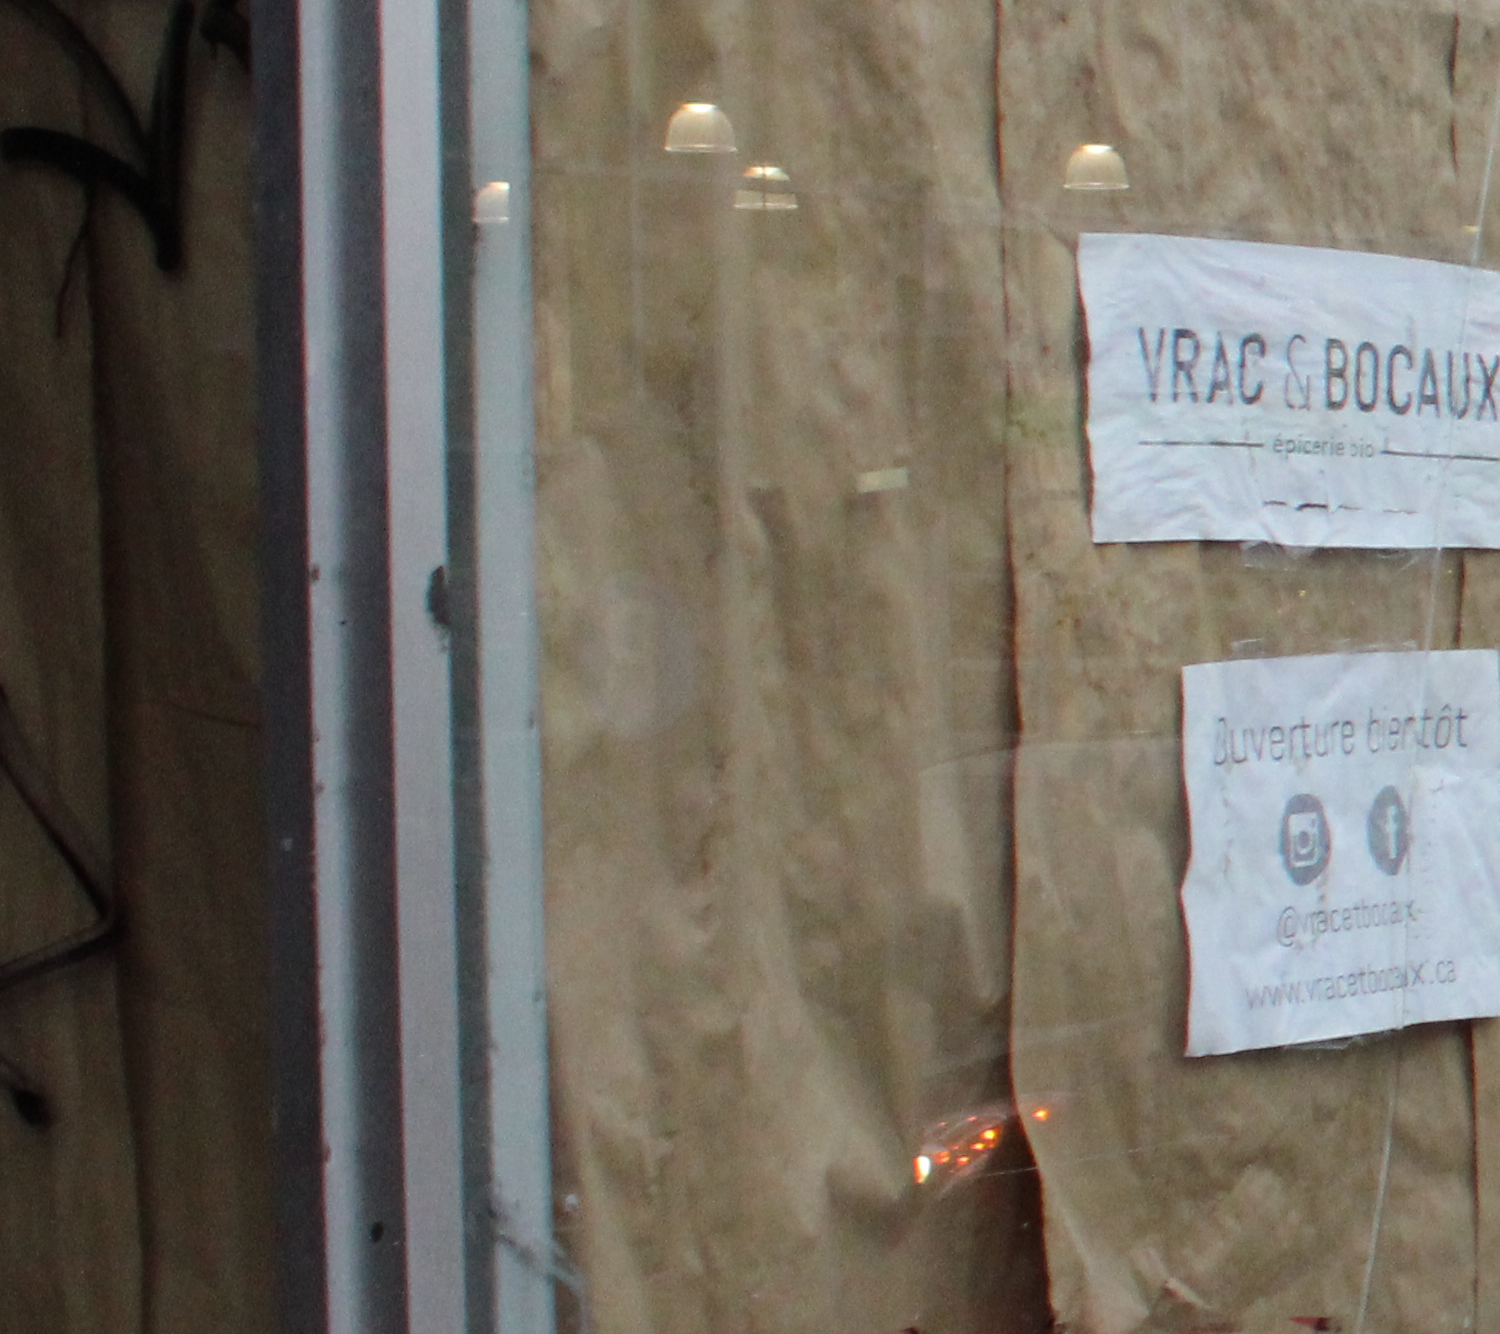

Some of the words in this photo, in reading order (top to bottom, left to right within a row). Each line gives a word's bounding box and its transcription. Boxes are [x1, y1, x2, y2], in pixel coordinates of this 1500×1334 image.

[1137, 326, 1267, 405] VRAC
[1283, 333, 1312, 411] &
[1324, 338, 1500, 421] BOCAUX
[1272, 432, 1345, 460] épicerie
[1213, 716, 1356, 766] Ouverture
